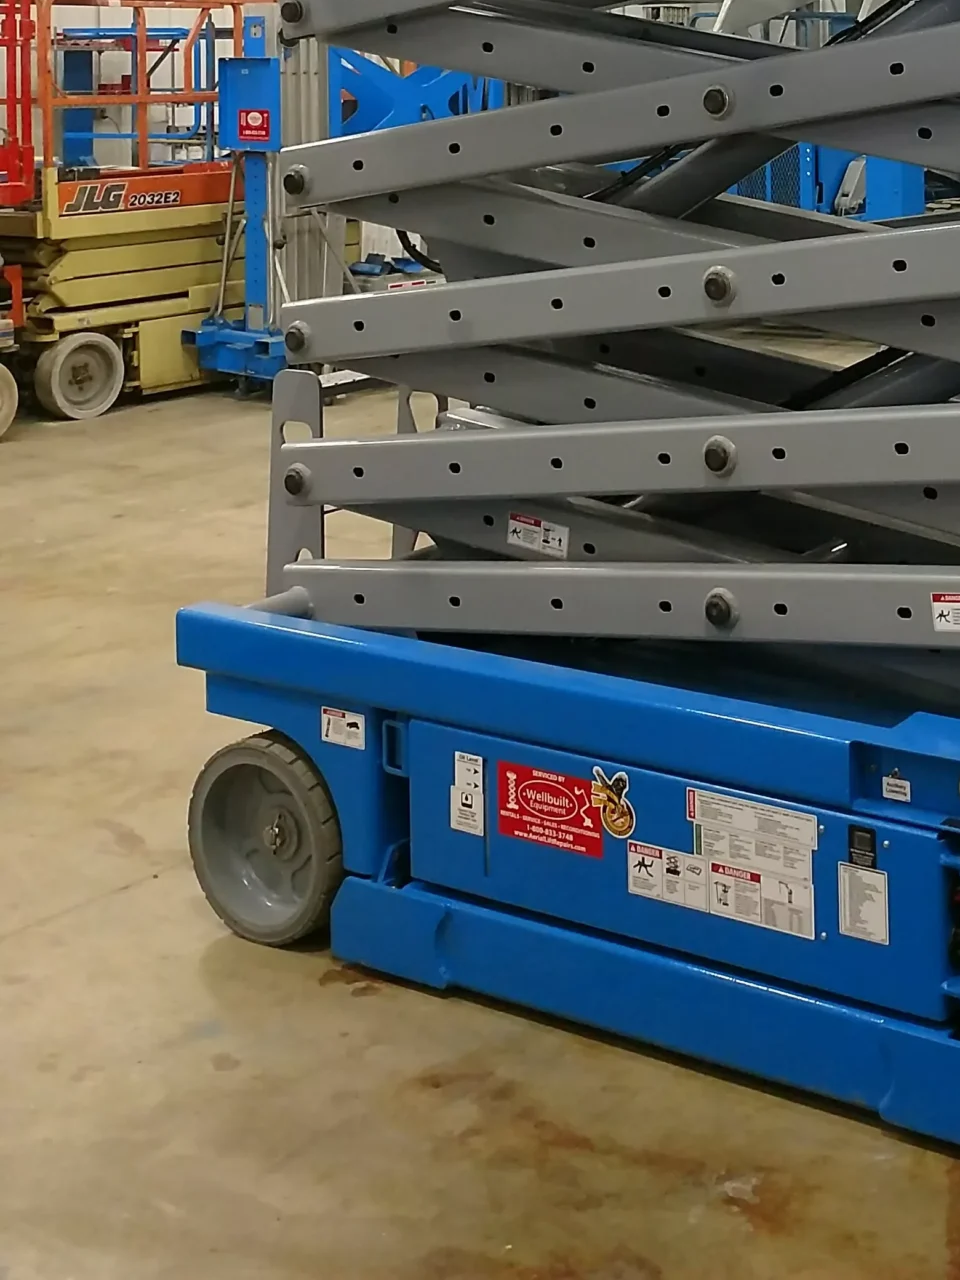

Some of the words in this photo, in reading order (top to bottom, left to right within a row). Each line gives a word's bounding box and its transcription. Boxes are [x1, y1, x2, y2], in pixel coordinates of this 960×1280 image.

[63, 182, 128, 214] JLG
[128, 190, 181, 208] 2032E2
[525, 788, 570, 808] Wellbuilt
[529, 801, 567, 816] Equipment
[636, 844, 660, 859] DANGER
[724, 867, 751, 880] DANGER
